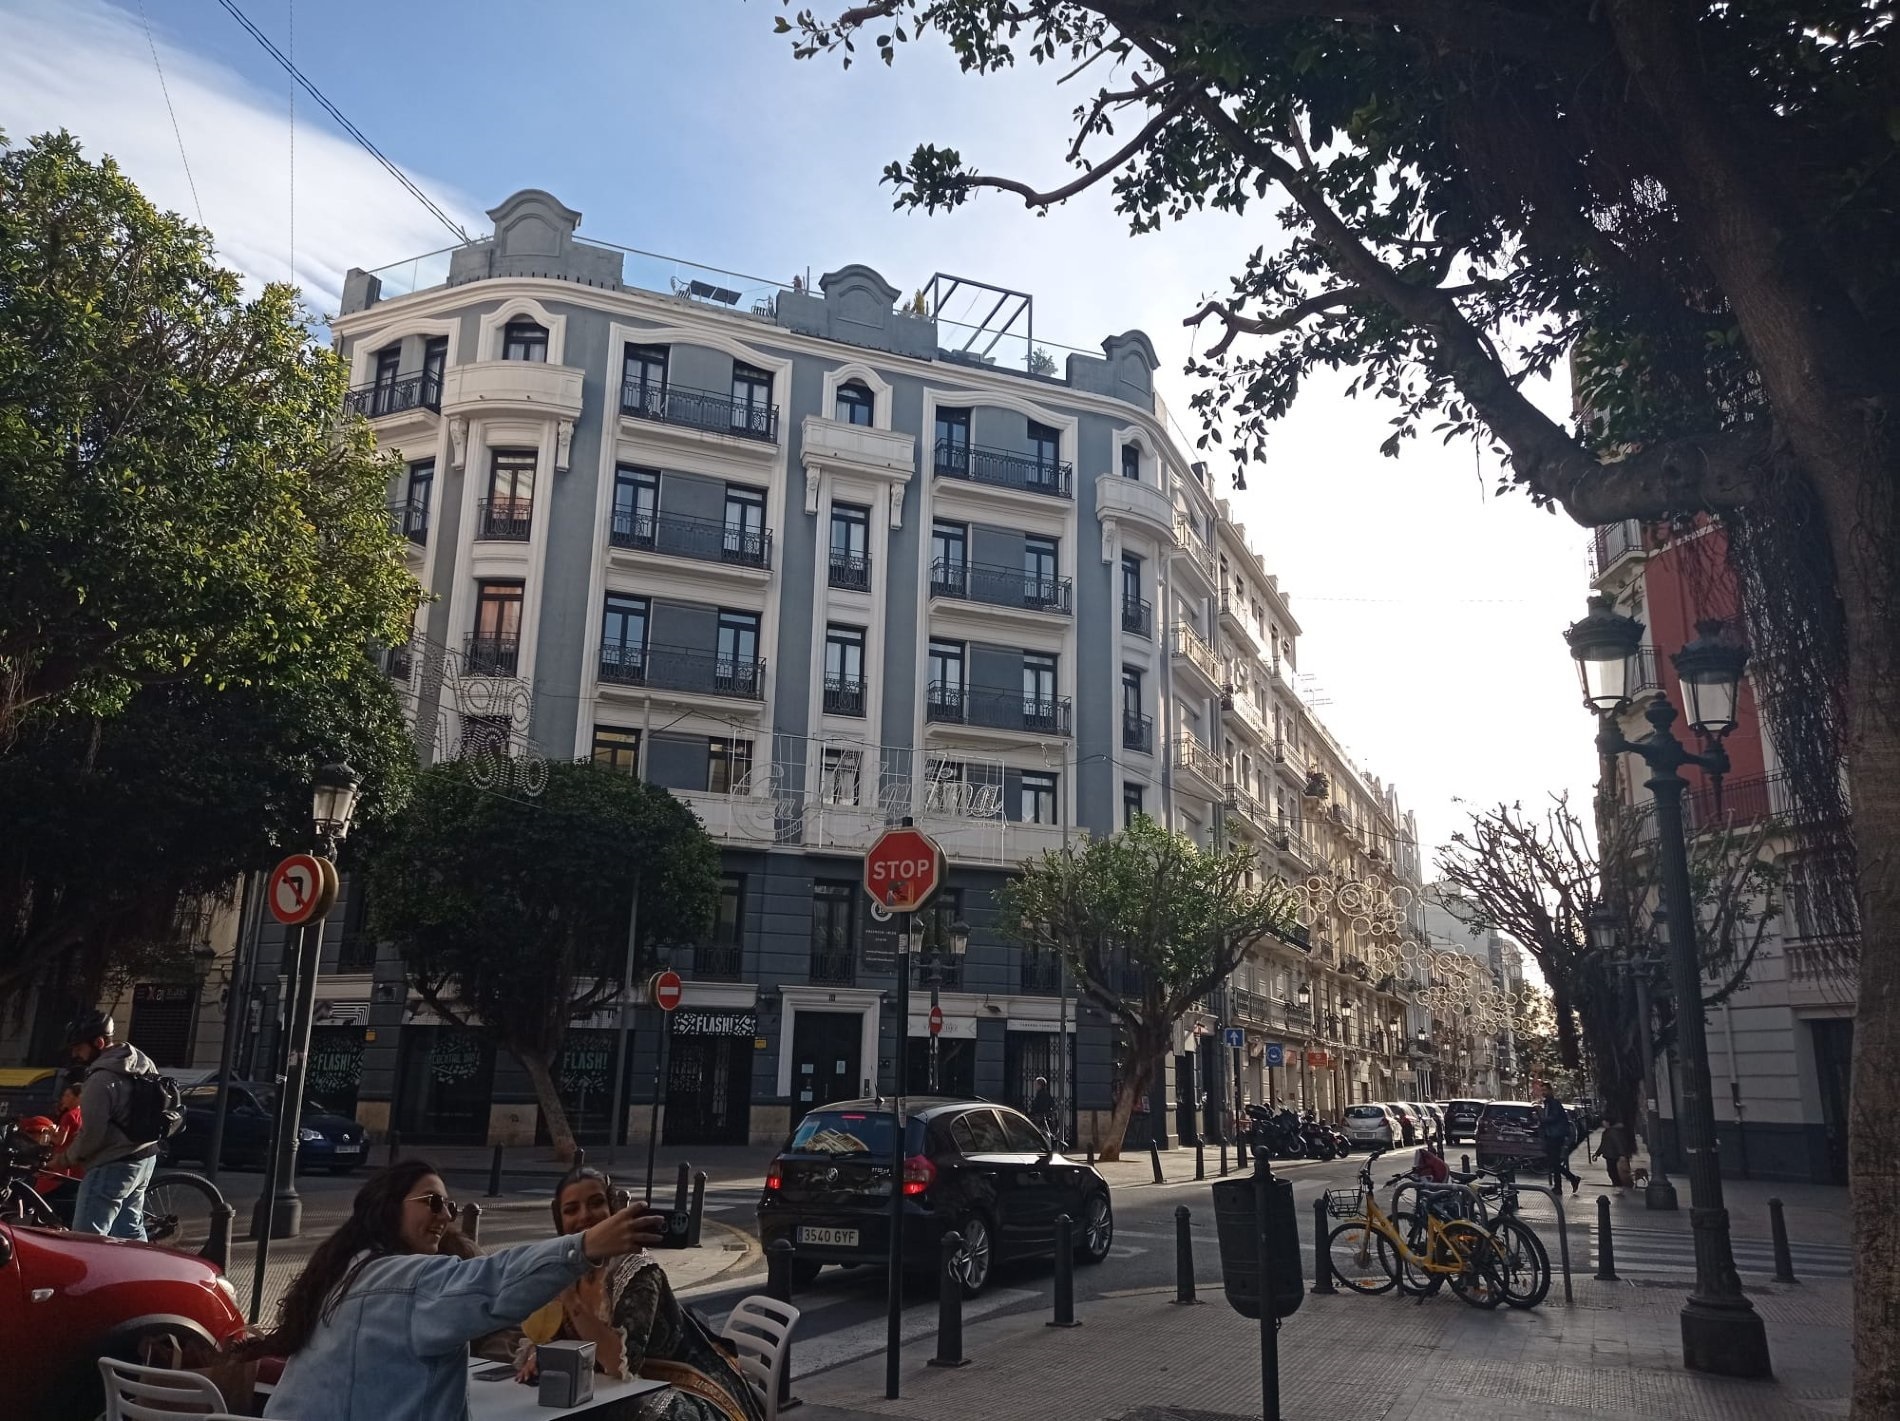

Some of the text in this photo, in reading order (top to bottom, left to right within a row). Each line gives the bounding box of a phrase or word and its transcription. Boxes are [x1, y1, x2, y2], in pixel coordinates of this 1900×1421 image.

[872, 859, 930, 880] STOP
[696, 1016, 734, 1033] FLASH!
[317, 1053, 351, 1071] FLASH!
[563, 1052, 608, 1070] FLASH!
[804, 1228, 857, 1244] 3540 GYF
